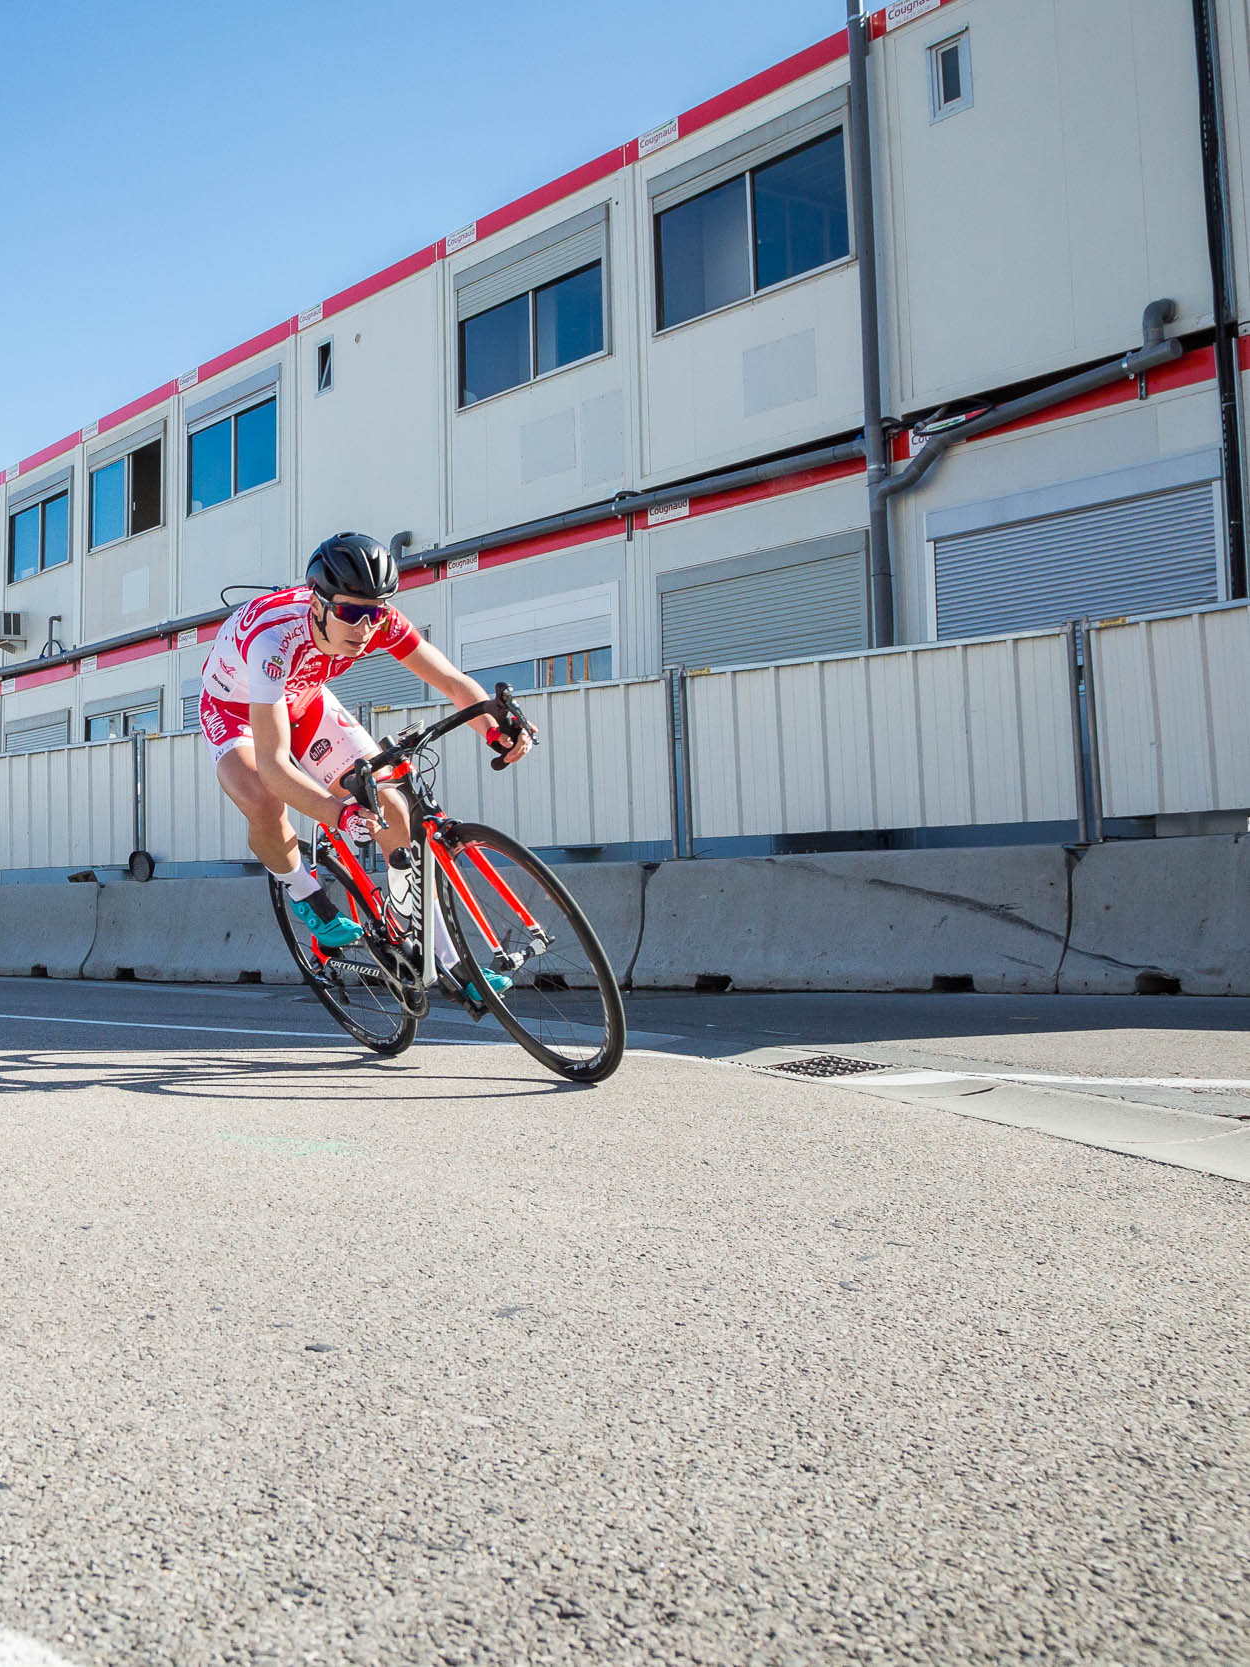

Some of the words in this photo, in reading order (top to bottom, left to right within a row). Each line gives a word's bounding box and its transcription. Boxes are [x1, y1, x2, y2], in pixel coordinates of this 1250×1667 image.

[887, 0, 932, 20] Cougna
[639, 122, 677, 148] Cougnaud
[649, 499, 687, 515] Cougnaud
[447, 554, 477, 569] Cougnaud
[330, 961, 381, 977] SPECIALIZED
